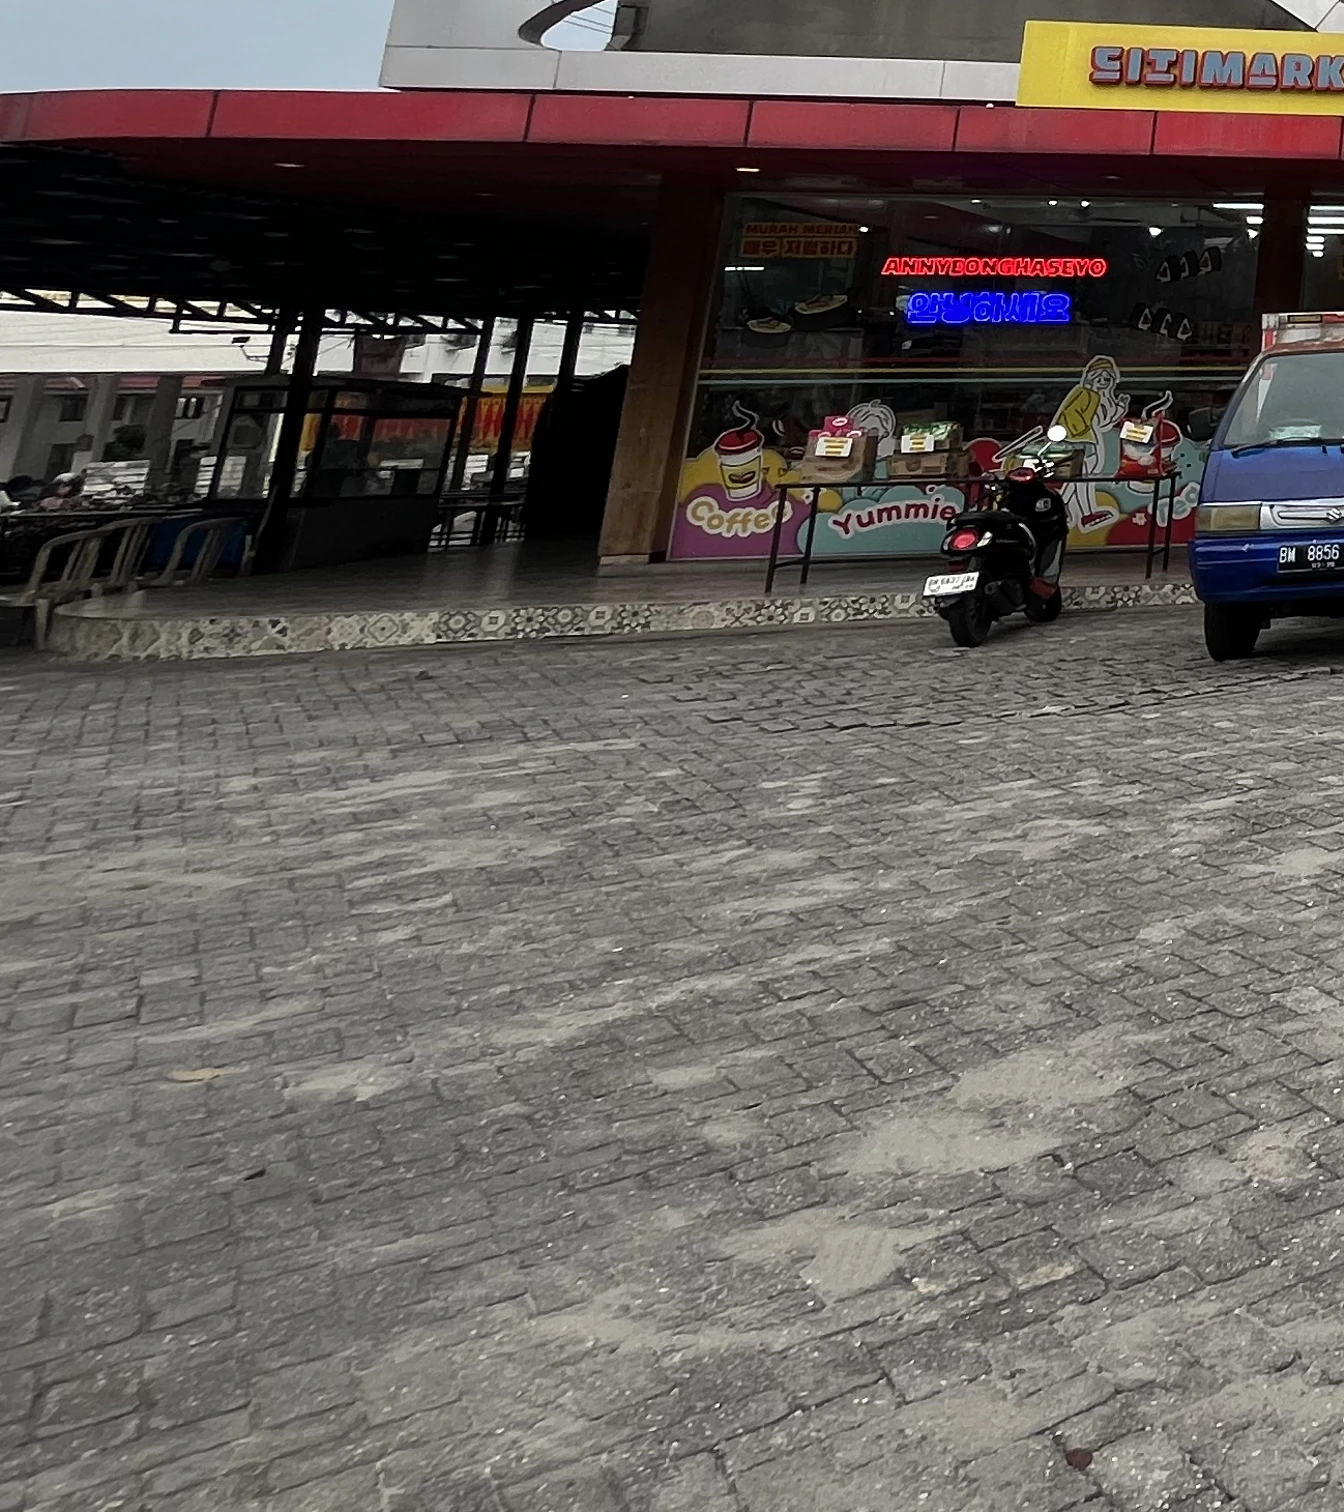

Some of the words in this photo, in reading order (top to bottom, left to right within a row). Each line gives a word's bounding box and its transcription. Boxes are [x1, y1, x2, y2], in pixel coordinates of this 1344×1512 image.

[745, 224, 799, 234] MURAH
[881, 257, 1108, 277] ANNYEONGHASEYO
[907, 292, 1071, 324] 안녕하세요
[1307, 544, 1340, 562] 8856
